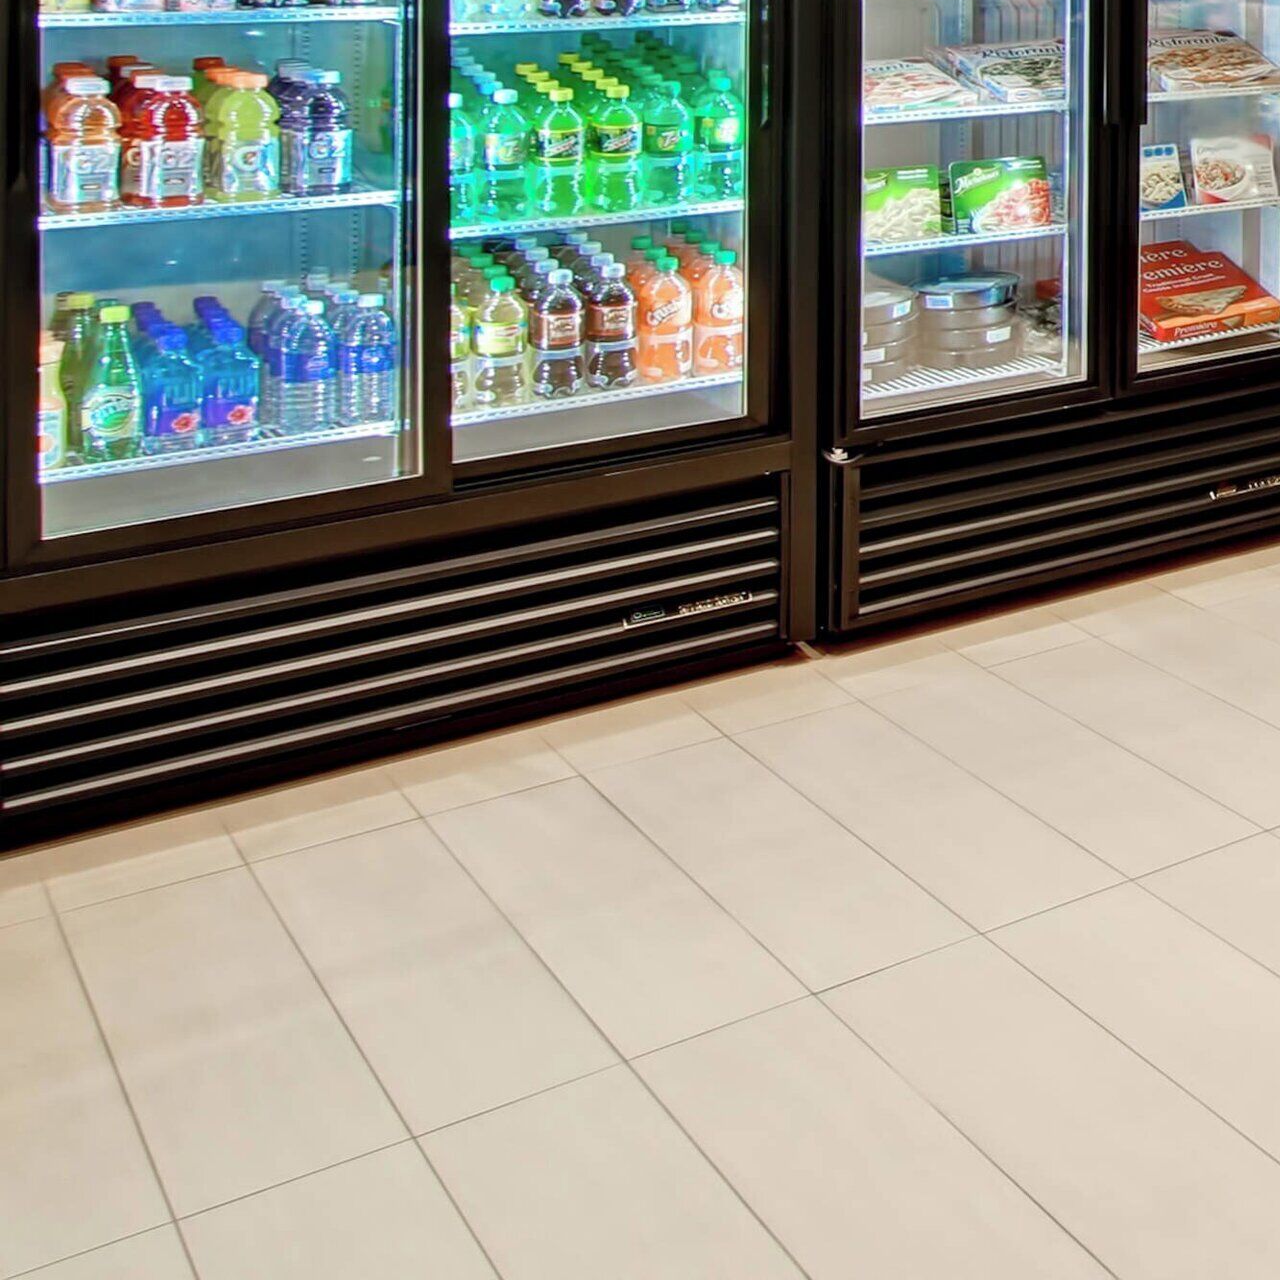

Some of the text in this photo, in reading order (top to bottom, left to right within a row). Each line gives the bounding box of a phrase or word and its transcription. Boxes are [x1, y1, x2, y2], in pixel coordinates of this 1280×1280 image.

[161, 148, 193, 168] G2
[234, 145, 262, 171] G
[310, 134, 347, 160] G2
[70, 150, 110, 174] G2
